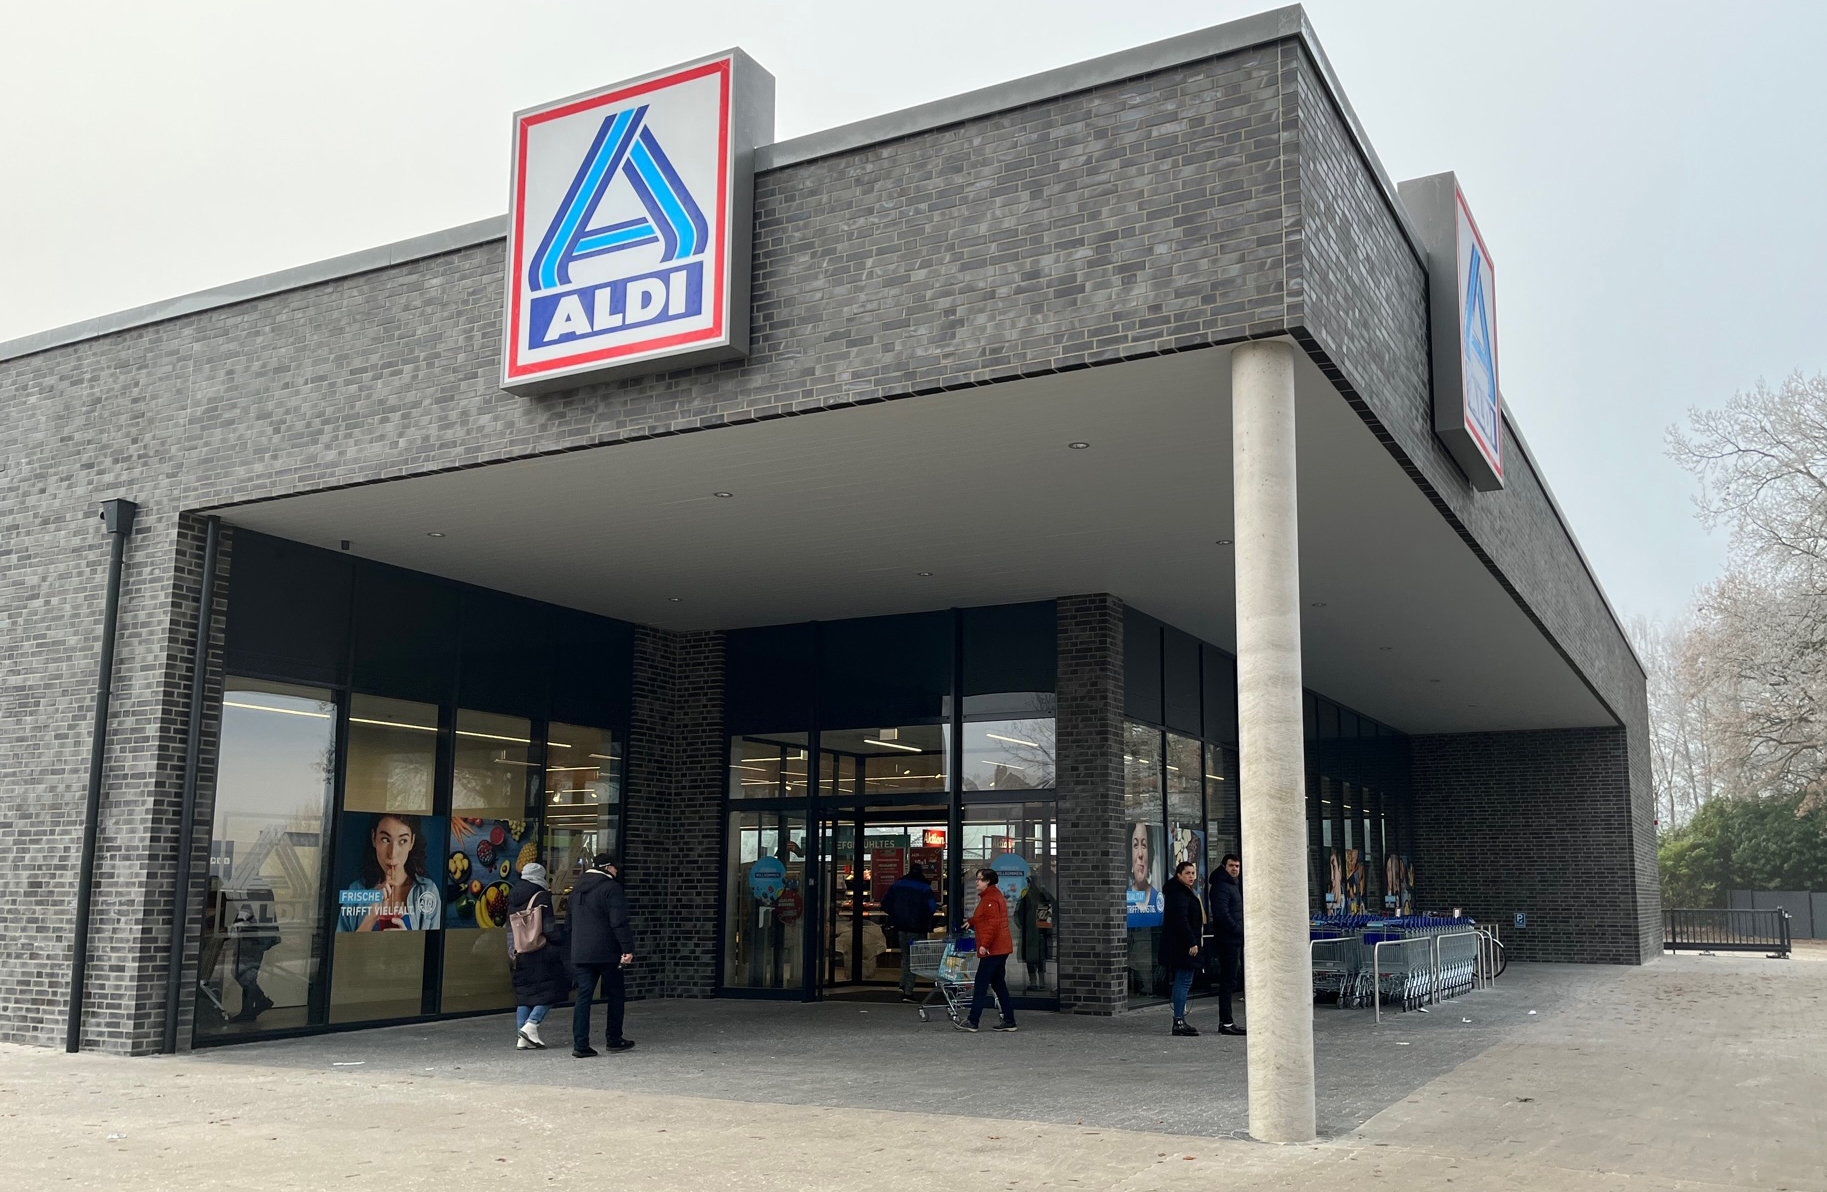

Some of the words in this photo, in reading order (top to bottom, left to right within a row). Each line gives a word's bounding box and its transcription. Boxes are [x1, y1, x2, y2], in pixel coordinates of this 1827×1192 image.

[543, 270, 688, 342] ALDI
[1467, 377, 1497, 447] ALDI
[342, 892, 380, 902] FRISCHE
[233, 903, 304, 923] ALDI
[341, 906, 373, 916] TRIFFT
[374, 906, 415, 916] VIELFALT.
[1517, 914, 1523, 922] P
